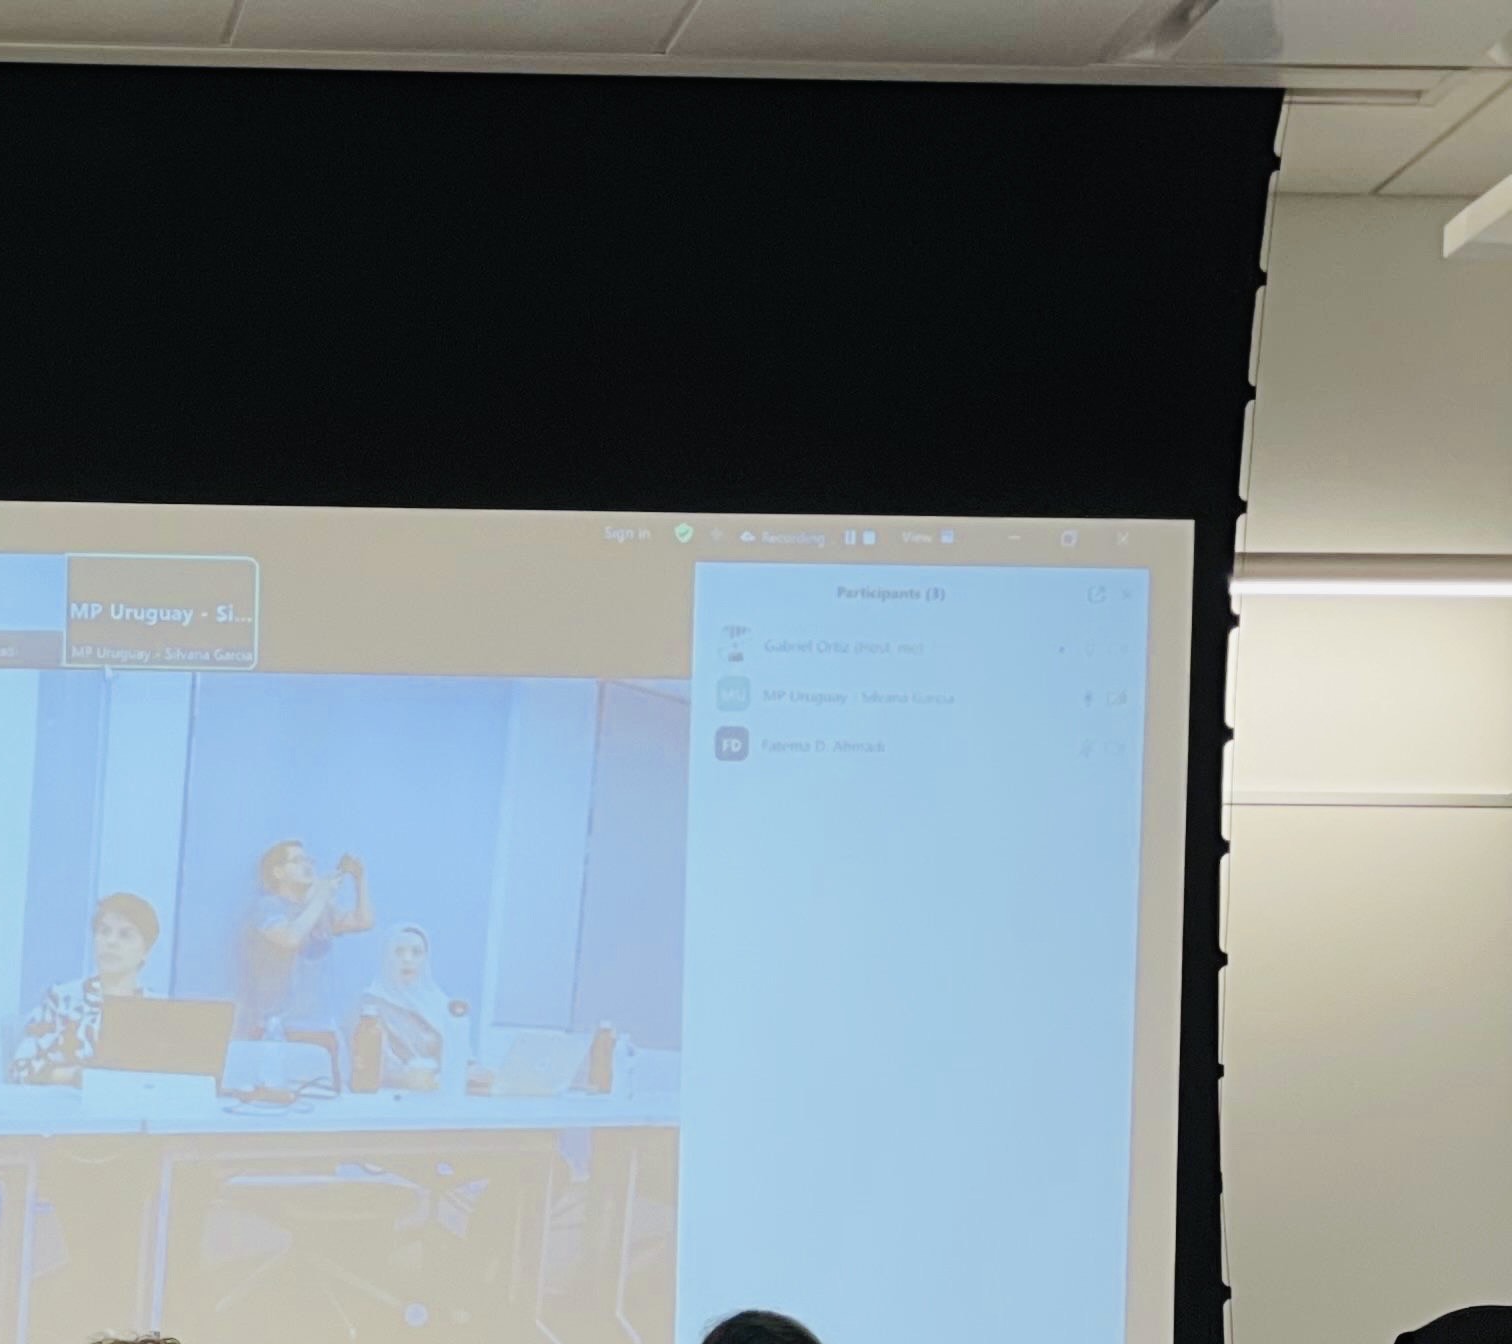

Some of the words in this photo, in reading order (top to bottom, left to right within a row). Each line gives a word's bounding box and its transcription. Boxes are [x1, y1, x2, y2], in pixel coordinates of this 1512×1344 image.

[603, 525, 635, 542] Sign
[836, 586, 922, 604] Participants
[70, 603, 103, 620] MP
[110, 604, 193, 627] Uruguay
[71, 645, 92, 658] MP
[96, 647, 151, 663] Uruguay
[722, 739, 742, 753] FD
